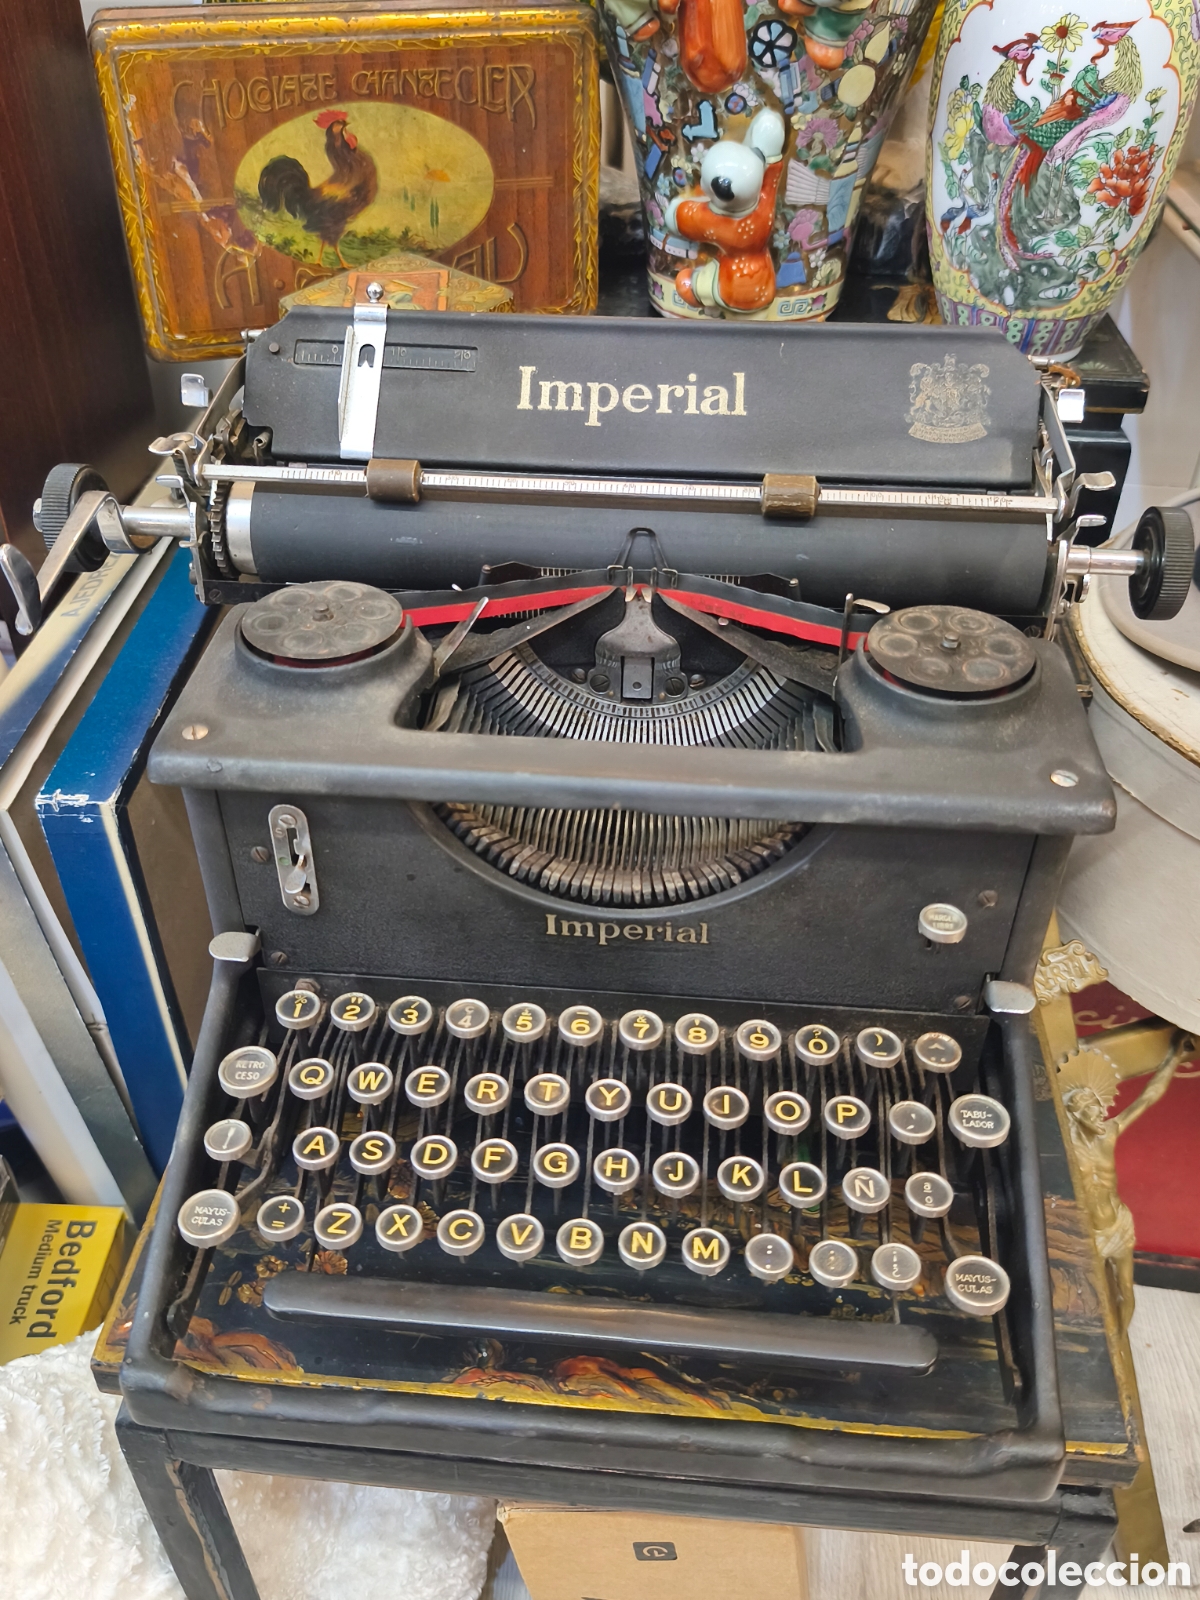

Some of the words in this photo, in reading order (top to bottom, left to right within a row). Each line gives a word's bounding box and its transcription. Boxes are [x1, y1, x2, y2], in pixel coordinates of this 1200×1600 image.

[517, 365, 747, 427] Imperial
[545, 914, 710, 945] Imperial
[342, 1005, 361, 1021] 2
[400, 1008, 419, 1025] 3
[515, 1015, 533, 1031] 5
[570, 1018, 591, 1035] 6
[633, 1023, 650, 1039] 7
[687, 1028, 708, 1043] 8
[749, 1033, 770, 1048] 9
[235, 1071, 260, 1081] CESO
[300, 1065, 325, 1085] Q
[358, 1071, 384, 1091] W
[417, 1073, 439, 1094] E
[476, 1080, 499, 1100] R
[539, 1081, 560, 1102] T
[599, 1086, 621, 1106] Y
[659, 1090, 682, 1111] U
[723, 1094, 730, 1115] I
[775, 1100, 802, 1121] O
[836, 1103, 858, 1124] P
[960, 1109, 992, 1120] TABU-
[962, 1119, 995, 1130] LADOR
[302, 1135, 326, 1156] A
[361, 1139, 384, 1160] S
[422, 1143, 448, 1165] D
[483, 1147, 506, 1169] F
[543, 1151, 568, 1173] G
[605, 1156, 628, 1178] H
[667, 1160, 684, 1182] J
[731, 1163, 752, 1187] K
[793, 1170, 813, 1193] L
[854, 1175, 875, 1199] Ñ
[191, 1215, 224, 1227] CULAS
[327, 1212, 352, 1235] Z
[386, 1213, 412, 1237] X
[449, 1218, 474, 1241] C
[510, 1222, 534, 1246] V
[569, 1227, 593, 1249] B
[631, 1231, 653, 1254] N
[692, 1237, 719, 1261] M
[27, 1219, 63, 1279] Medium
[26, 1220, 98, 1338] Bedford
[957, 1283, 994, 1295] CULAS
[9, 1284, 39, 1326] truck
